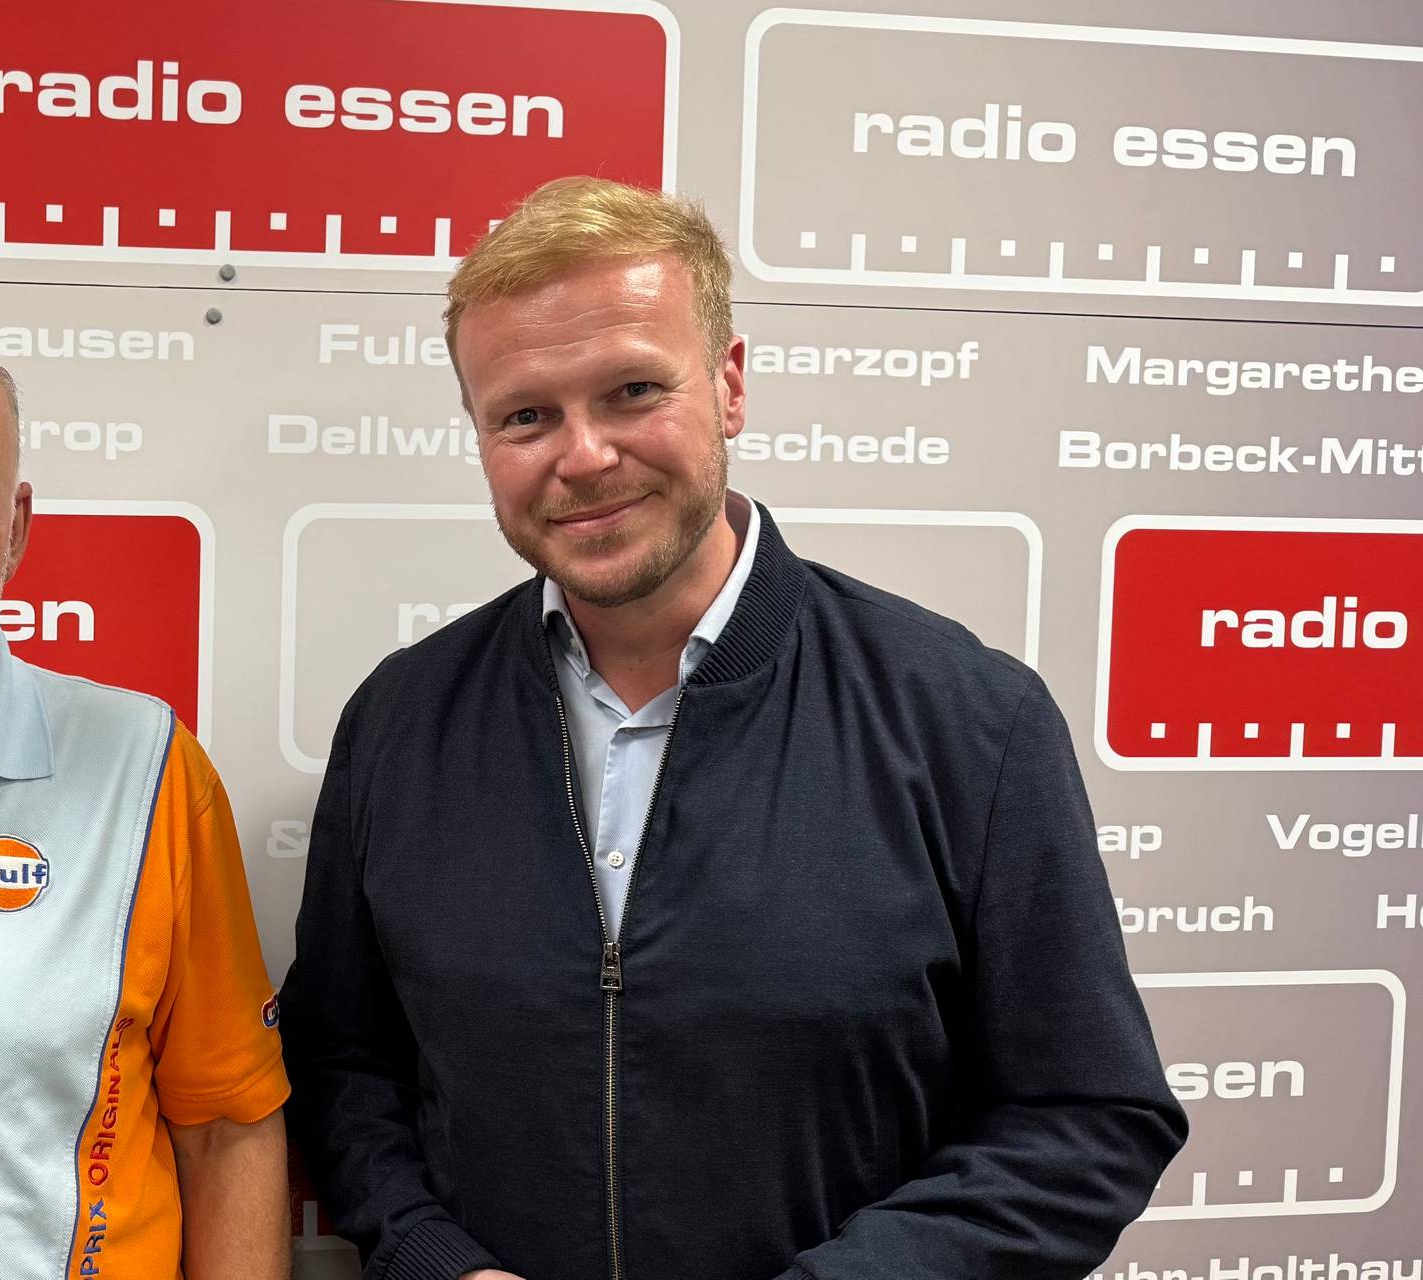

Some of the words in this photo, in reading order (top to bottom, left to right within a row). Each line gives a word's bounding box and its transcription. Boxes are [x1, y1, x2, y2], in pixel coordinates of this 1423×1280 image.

[284, 82, 565, 138] essen
[853, 104, 1076, 163] radio
[1113, 124, 1356, 177] essen
[743, 333, 979, 386] aarzopf
[1086, 346, 1423, 396] Margarethe
[727, 424, 950, 464] schede
[1058, 430, 1423, 476] Borbeck-Mit
[1201, 596, 1408, 649] radio
[1266, 814, 1423, 857] Vogel
